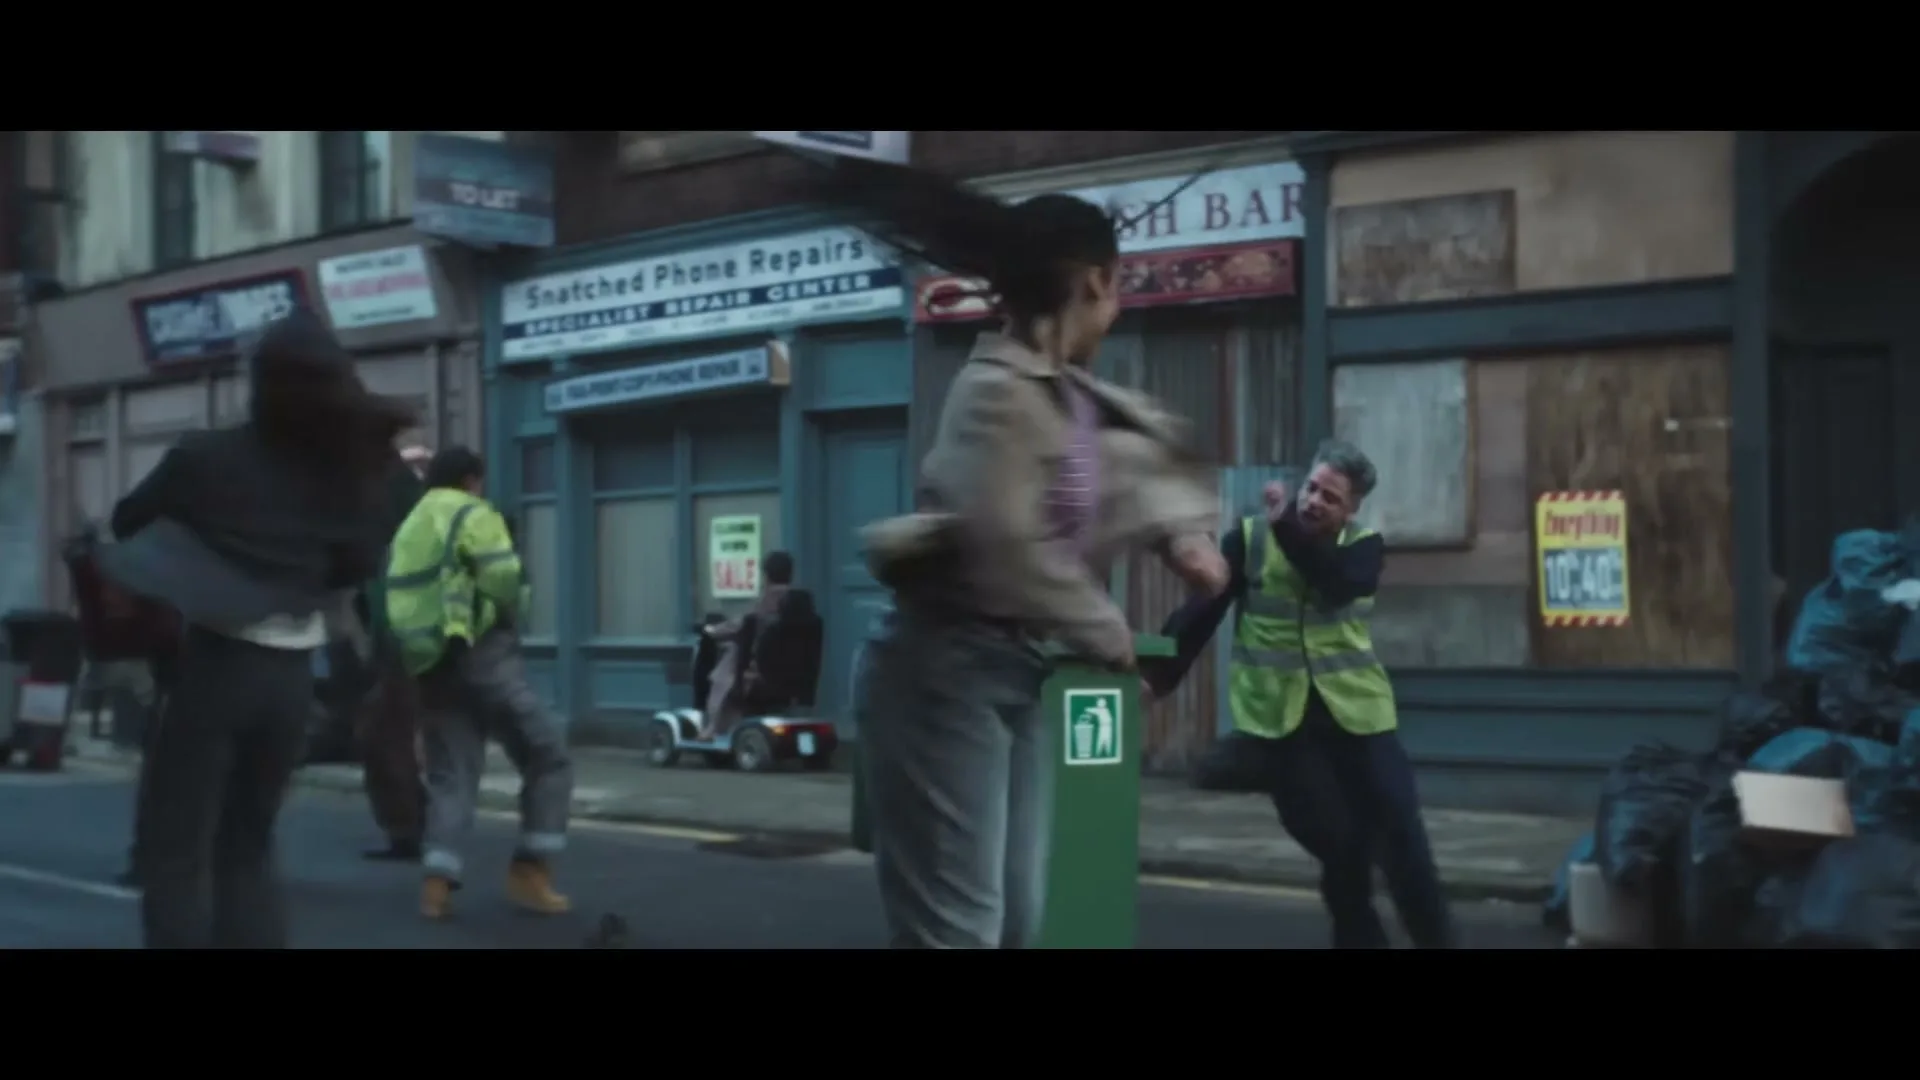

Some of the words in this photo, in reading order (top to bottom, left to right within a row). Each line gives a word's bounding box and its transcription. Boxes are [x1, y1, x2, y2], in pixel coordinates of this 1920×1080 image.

[525, 268, 643, 310] Snatched
[654, 259, 738, 290] Phone
[749, 237, 863, 276] Repairs
[525, 307, 650, 336] SPECIALIST
[665, 291, 750, 316] REPAIR
[767, 273, 871, 301] CENTER
[1544, 510, 1620, 540] Everything
[715, 558, 756, 591] SALE
